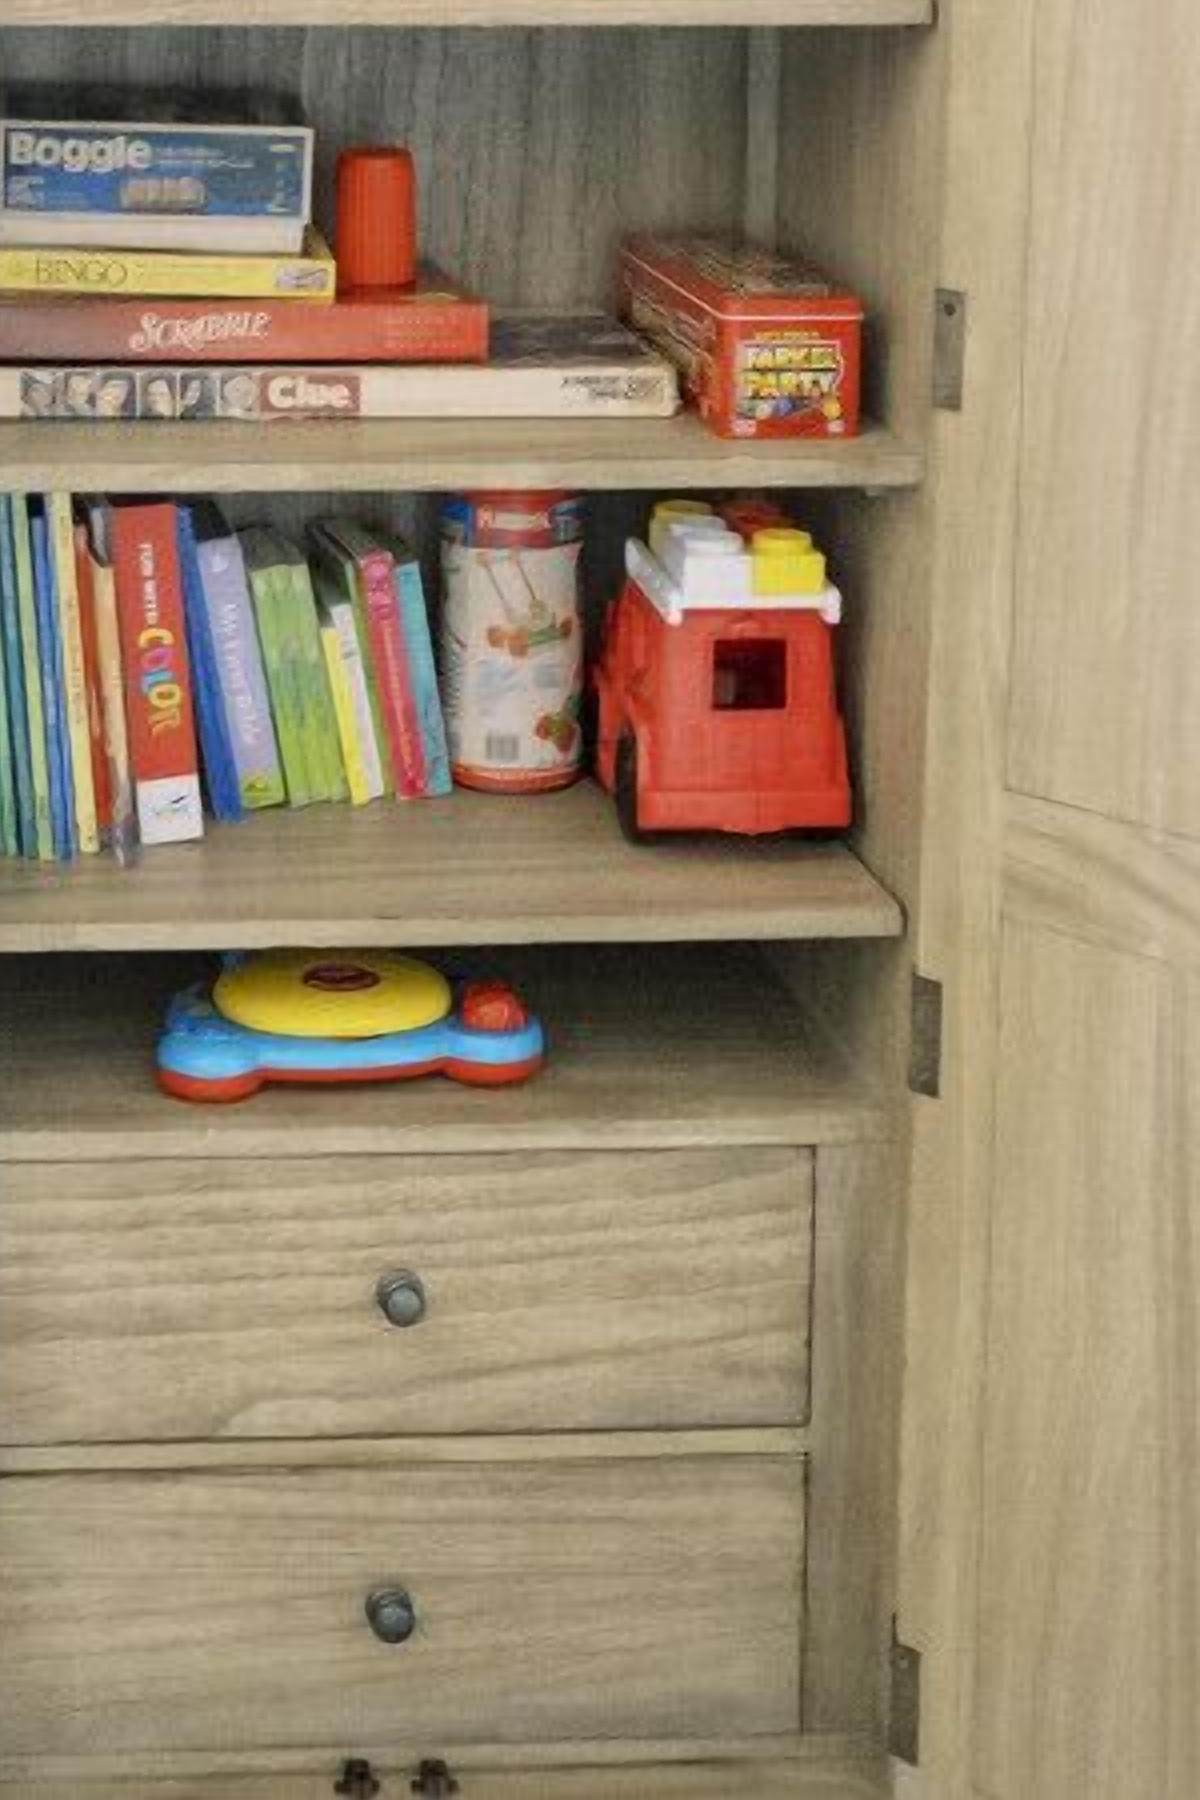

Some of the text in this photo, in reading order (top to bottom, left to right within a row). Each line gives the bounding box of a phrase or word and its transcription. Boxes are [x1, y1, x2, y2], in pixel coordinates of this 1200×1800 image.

[7, 132, 152, 173] Boggle
[35, 258, 129, 288] BINGO
[268, 374, 349, 409] Clue
[137, 626, 184, 737] COLOR
